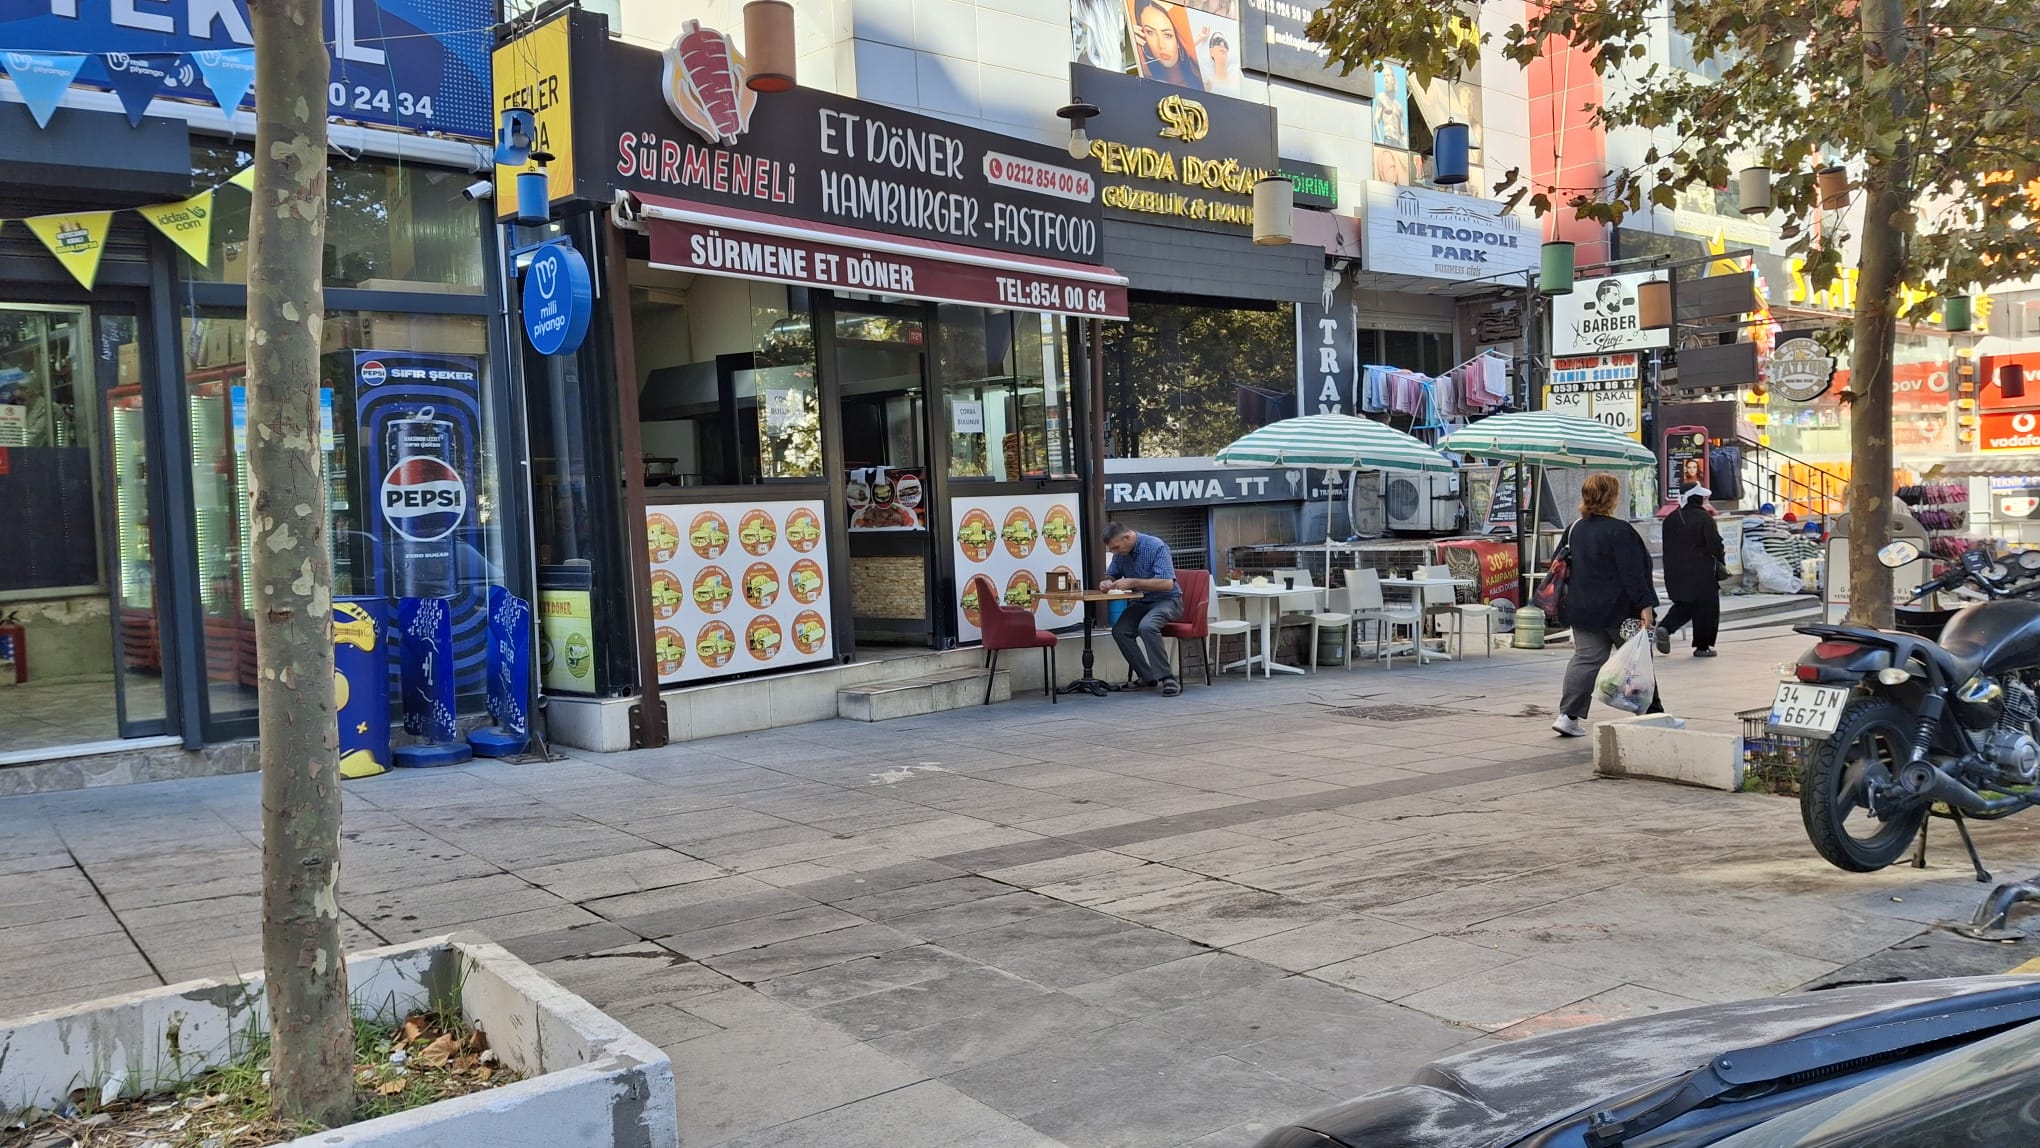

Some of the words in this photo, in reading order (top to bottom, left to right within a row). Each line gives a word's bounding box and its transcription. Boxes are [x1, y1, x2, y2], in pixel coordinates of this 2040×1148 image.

[129, 65, 164, 77] piyango
[354, 86, 390, 112] 24
[398, 92, 433, 119] 34
[819, 108, 859, 158] ET
[865, 118, 964, 180] DÖNER
[1089, 139, 1178, 181] SEVDA
[1006, 167, 1034, 185] 0212
[1036, 170, 1057, 189] 854
[1058, 174, 1073, 193] 00
[1076, 177, 1089, 196] 64
[820, 169, 978, 237] HAMBURGER
[1190, 199, 1208, 220] &
[157, 212, 189, 225] iddaa
[175, 219, 201, 232] com
[1396, 220, 1518, 249] METROPOLE
[691, 229, 808, 278] SÜRMENE
[814, 252, 839, 282] ET
[846, 253, 915, 292] DÖNER
[1431, 244, 1488, 263] PARK
[996, 277, 1060, 307] TEL:854
[1064, 285, 1083, 310] 00
[1087, 289, 1106, 312] 64
[540, 300, 557, 319] milli
[534, 314, 565, 338] piyango
[1583, 315, 1636, 333] BARBER
[1593, 333, 1624, 352] Shop
[362, 370, 385, 378] PEPSI
[391, 368, 426, 380] SIFIR
[429, 370, 474, 383] ŞEKER
[1553, 383, 1579, 393] 0539
[1583, 382, 1600, 391] 704
[1623, 380, 1634, 388] 12
[1555, 394, 1581, 406] SAÇ
[1595, 391, 1633, 402] SAKAL
[387, 489, 461, 508] PEPSI
[1487, 550, 1514, 571] 30%
[1780, 686, 1799, 703] 34
[1784, 706, 1826, 727] 6671
